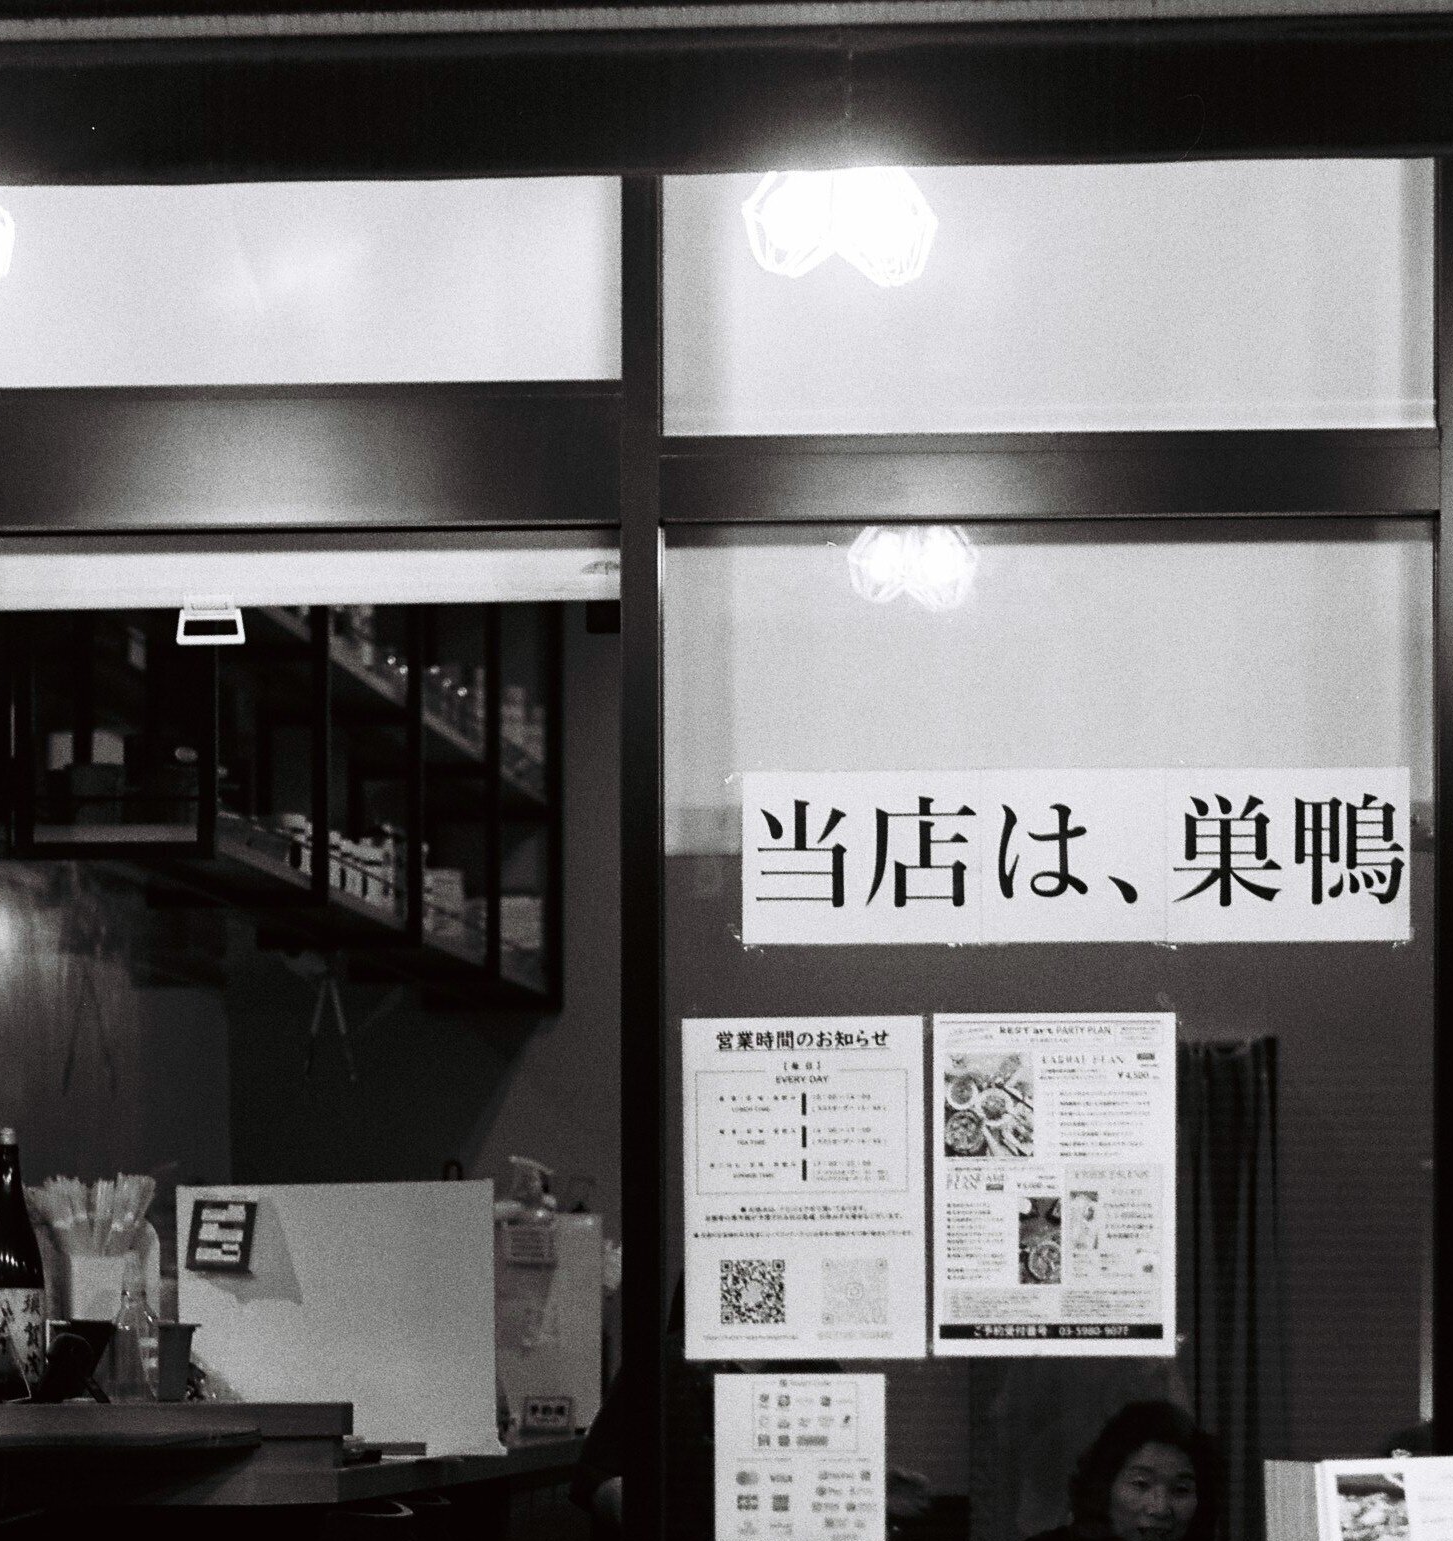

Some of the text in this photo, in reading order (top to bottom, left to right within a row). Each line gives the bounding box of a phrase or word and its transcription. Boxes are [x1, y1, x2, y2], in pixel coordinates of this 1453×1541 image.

[754, 792, 1406, 909] 当店は、巣鴨
[1055, 1025, 1086, 1035] PARTY
[1087, 1025, 1113, 1036] PLAN
[716, 1029, 890, 1049] 営業時間のお知らせ
[775, 1075, 829, 1084] EVERY DAY
